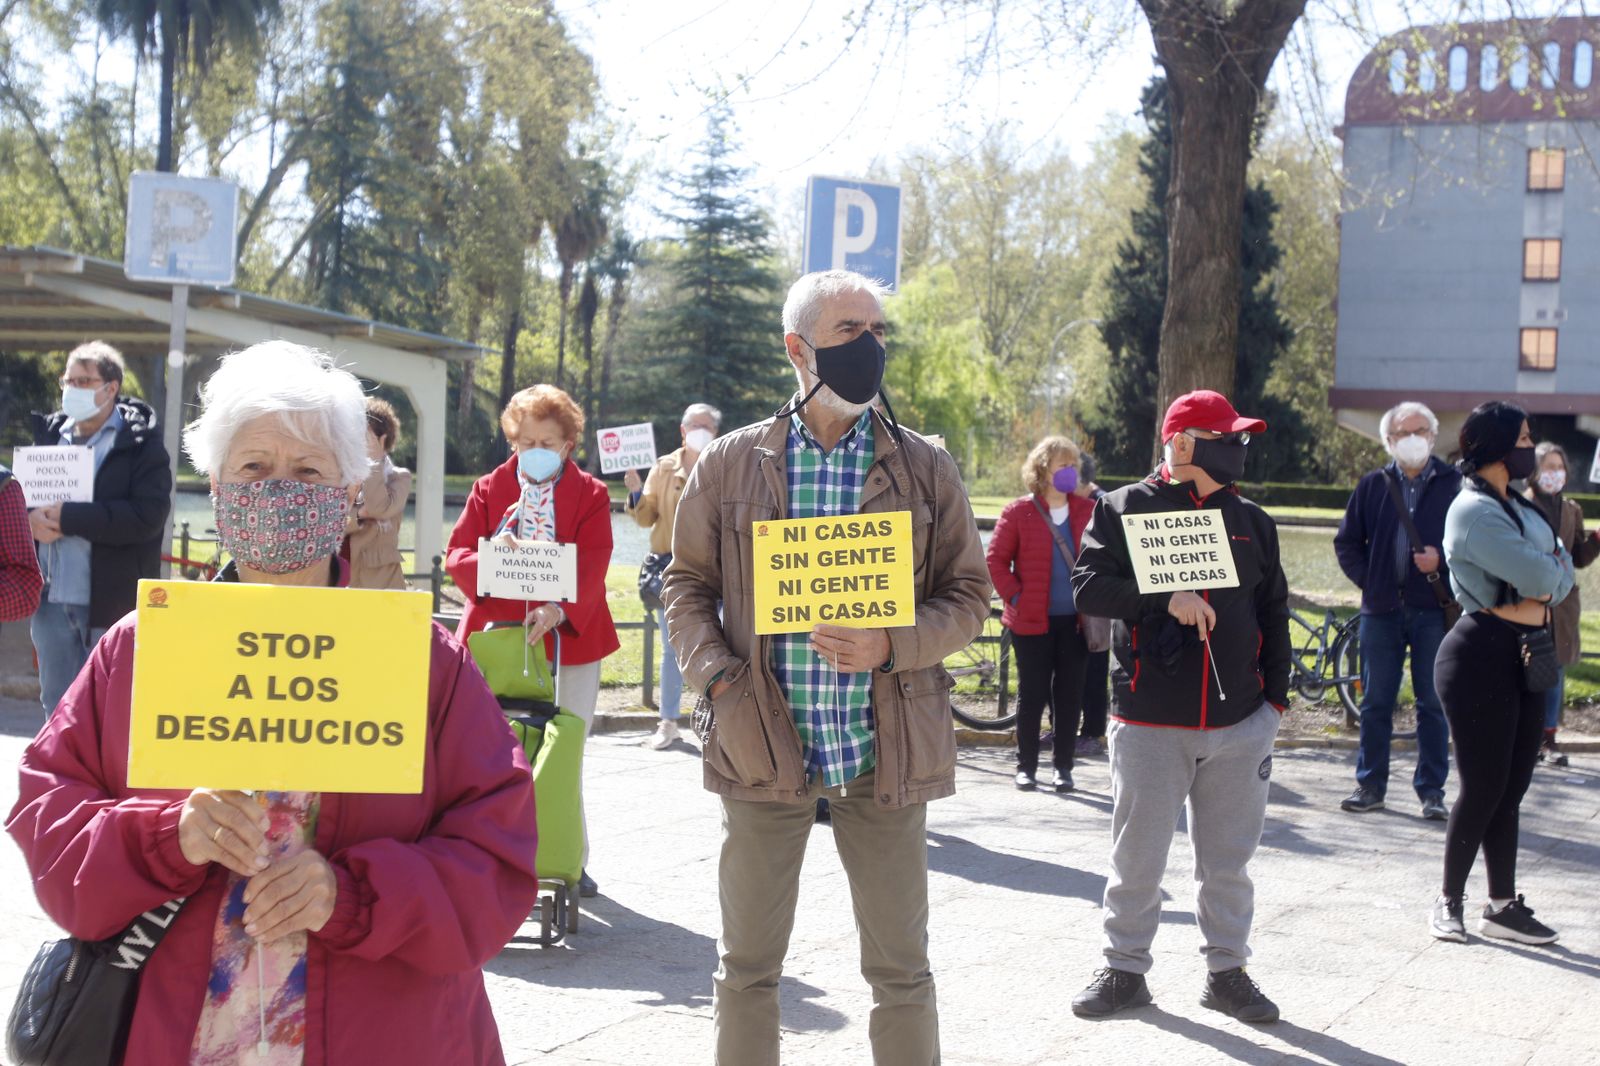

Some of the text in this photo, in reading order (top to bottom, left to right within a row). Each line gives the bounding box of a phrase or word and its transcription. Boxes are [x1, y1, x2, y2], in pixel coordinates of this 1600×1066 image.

[150, 188, 213, 268] P
[832, 187, 878, 272] P
[27, 453, 79, 463] RIQUEZA DE
[603, 453, 653, 470] DIGNA
[36, 467, 68, 476] POCOS,
[25, 480, 79, 489] POBREZA DE
[31, 493, 71, 501] MUCHOS
[1143, 519, 1160, 530] NI
[1164, 515, 1212, 529] CASAS
[783, 520, 893, 543] NI CASAS
[1140, 537, 1166, 549] SIN
[1169, 533, 1219, 547] GENTE
[519, 547, 541, 556] SOY
[543, 548, 561, 558] YO,
[770, 547, 896, 570] SIN GENTE
[1149, 551, 1219, 566] NI GENTE
[502, 558, 553, 569] MAÑANA
[495, 570, 559, 582] PUEDES SER
[1150, 568, 1227, 585] SIN CASAS
[520, 584, 535, 593] TÚ
[778, 574, 889, 596] NI GENTE
[772, 600, 897, 623] SIN CASAS
[236, 631, 336, 660] STOP
[227, 674, 339, 702] A LOS
[155, 714, 404, 747] DESAHUCIOS
[109, 923, 156, 970] MY
